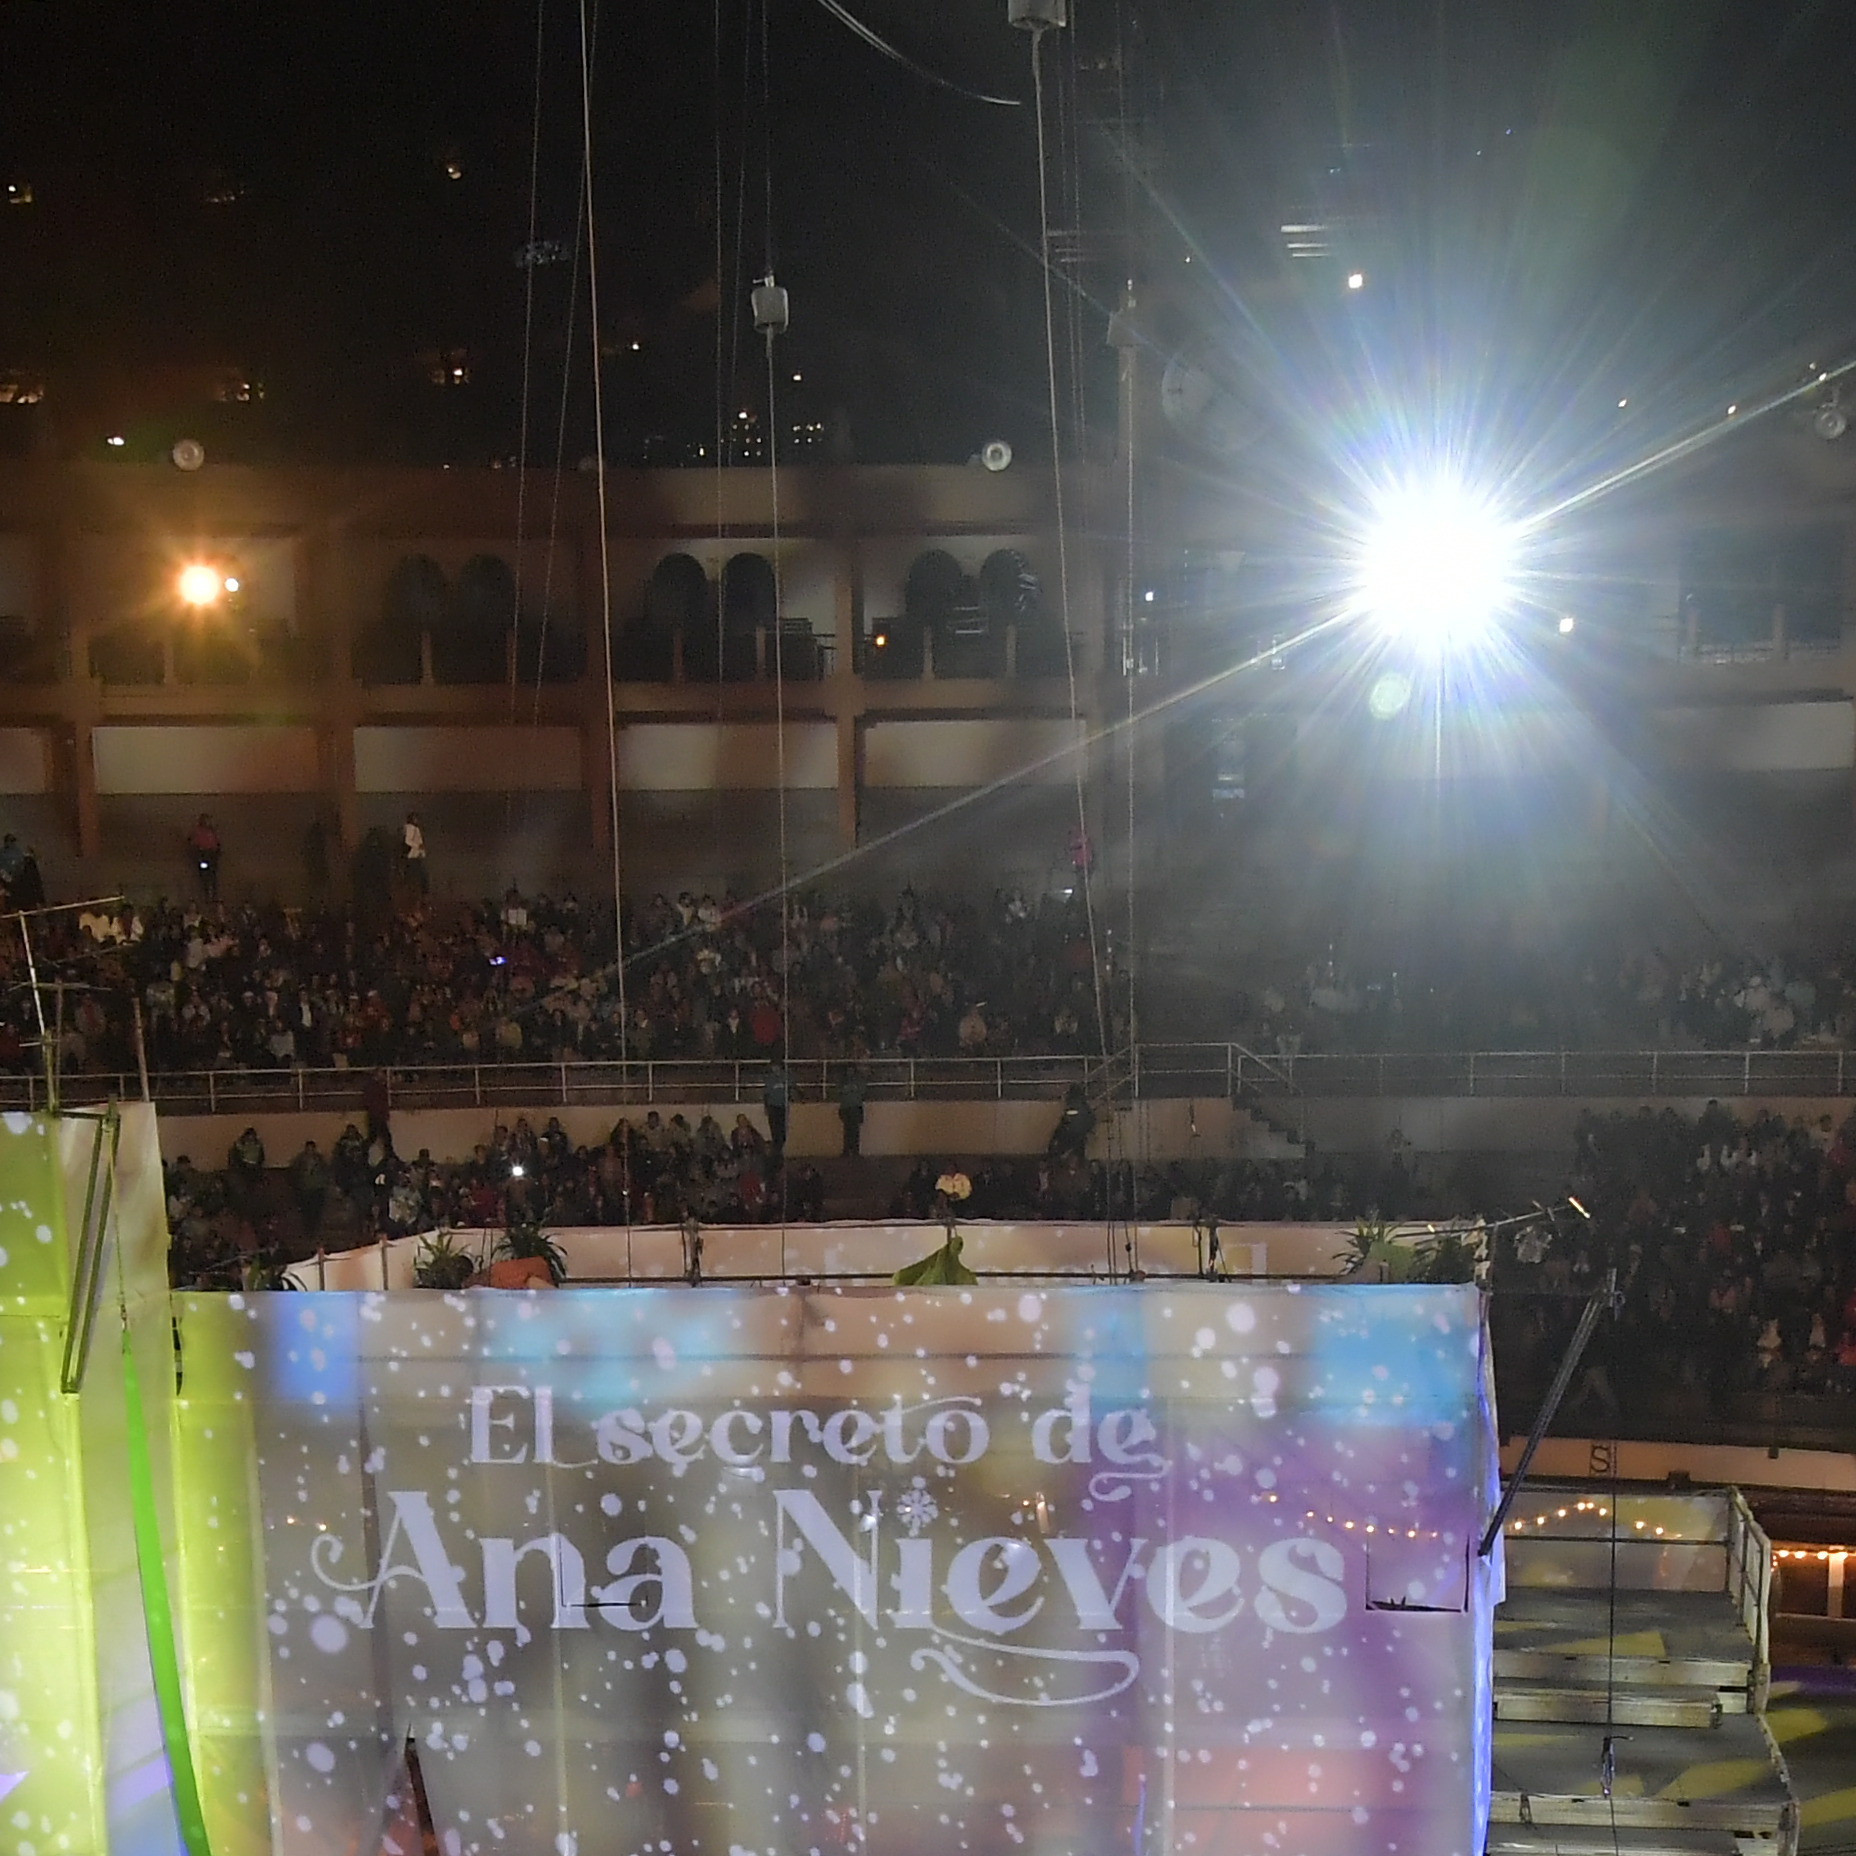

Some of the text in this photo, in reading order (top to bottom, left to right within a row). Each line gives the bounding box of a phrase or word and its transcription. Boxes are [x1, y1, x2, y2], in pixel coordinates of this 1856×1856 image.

[470, 1382, 1172, 1499] El secreto de
[311, 1489, 1348, 1706] Ana Nieves
